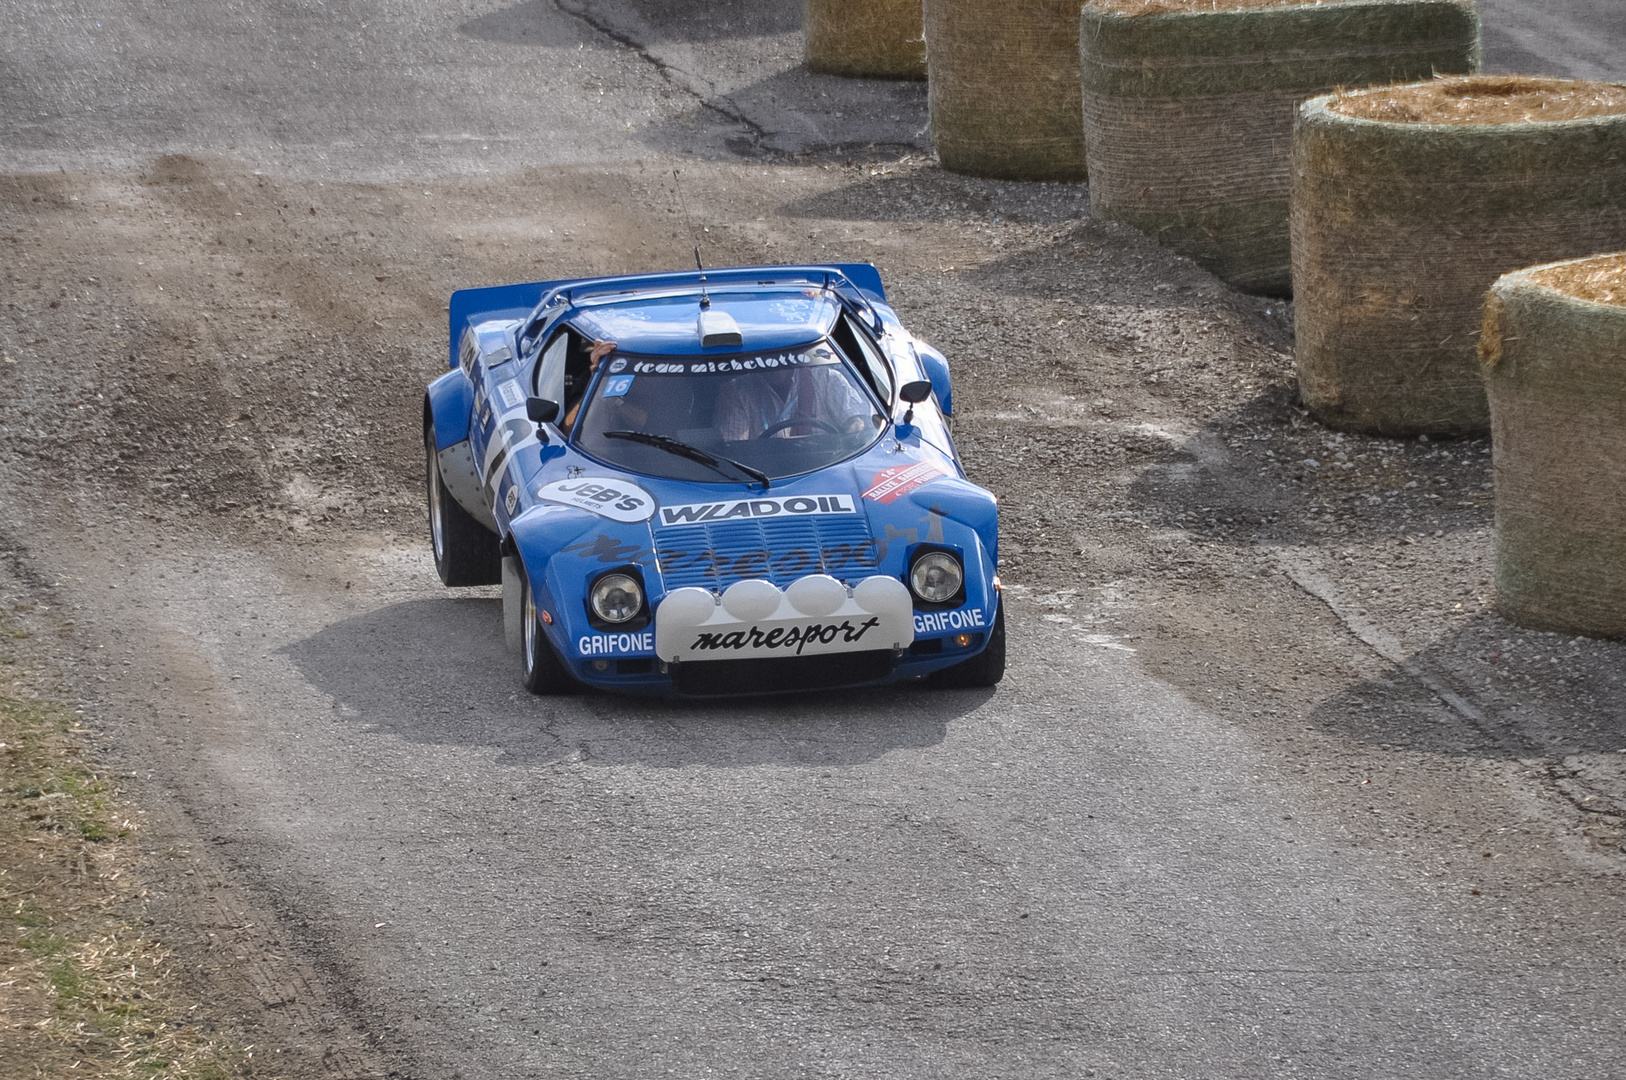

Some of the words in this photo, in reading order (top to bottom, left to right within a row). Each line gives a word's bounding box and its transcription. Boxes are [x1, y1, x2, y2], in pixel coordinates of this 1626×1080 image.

[633, 361, 685, 374] team
[690, 353, 812, 373] michelotto
[606, 378, 629, 394] 16
[558, 482, 646, 512] JEB'S
[868, 480, 899, 499] RALLYE
[662, 496, 852, 524] WLADOIL
[913, 608, 985, 633] GRIFONE
[579, 633, 653, 656] GRIFONE
[690, 616, 880, 655] maresport
